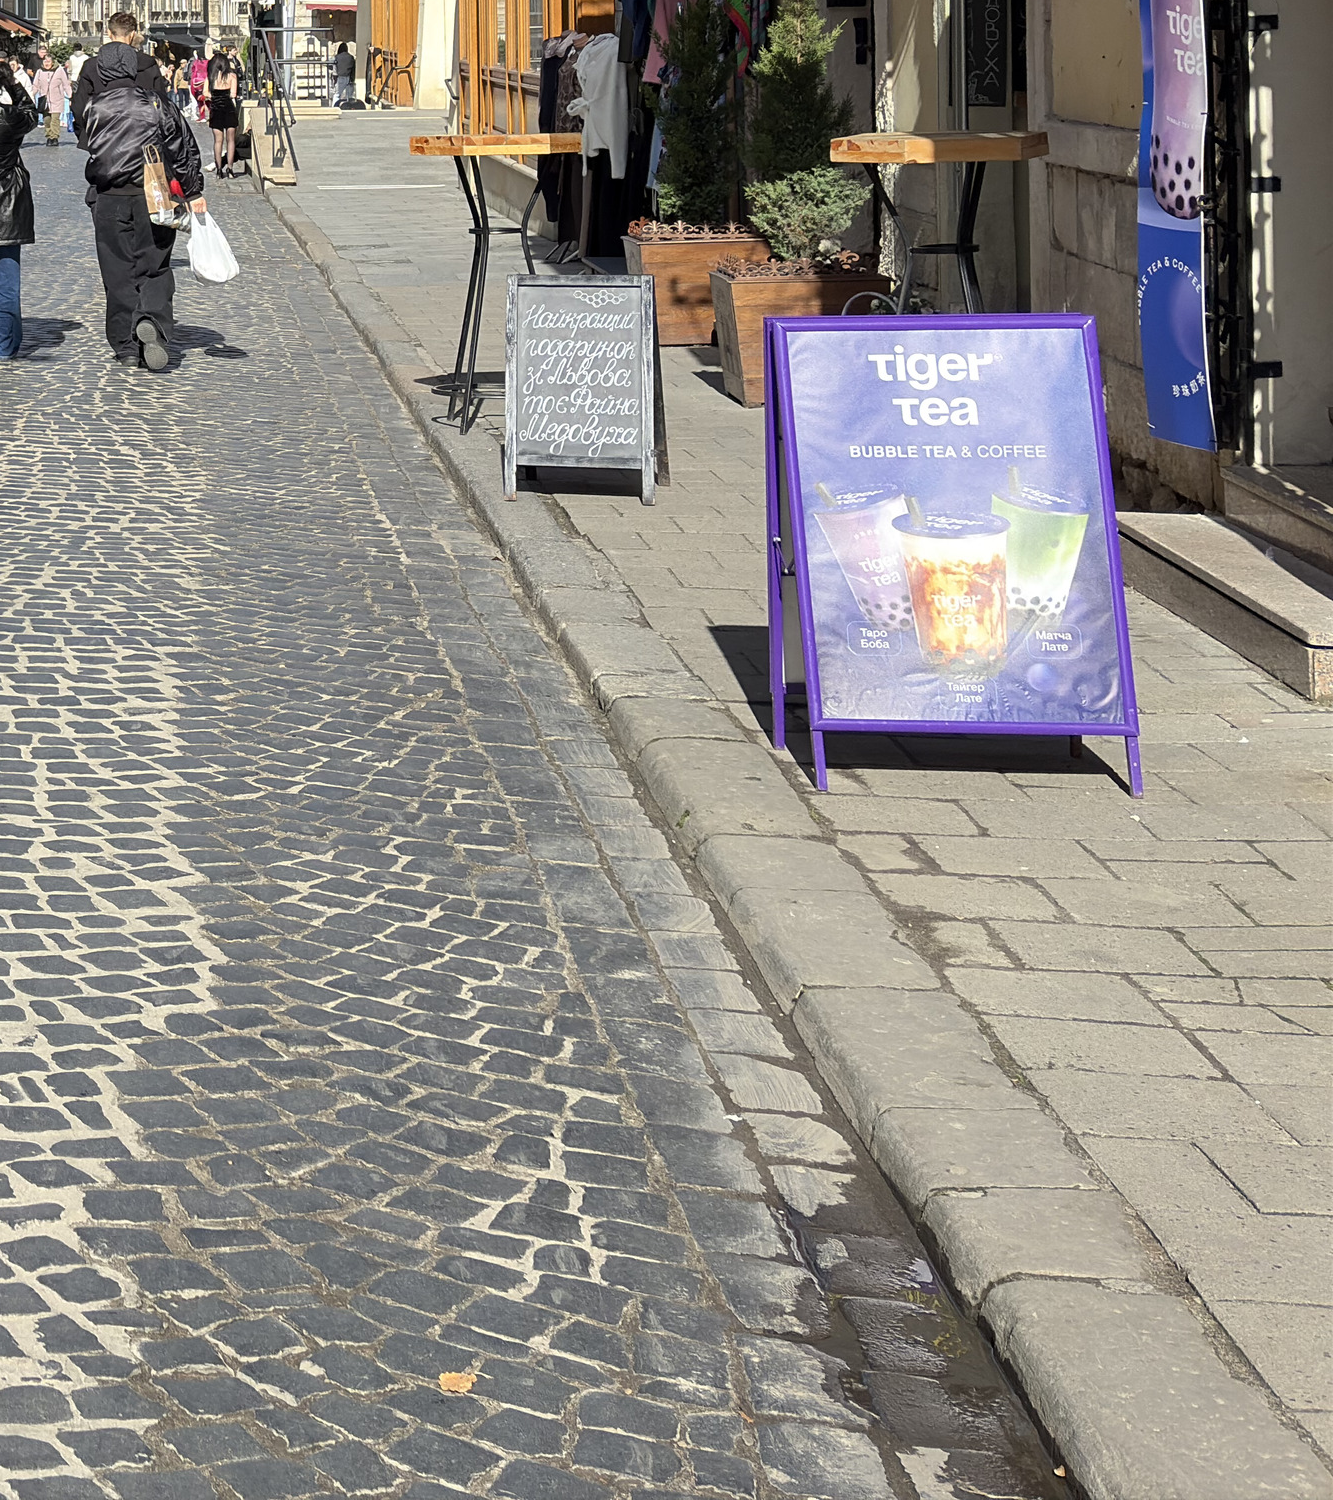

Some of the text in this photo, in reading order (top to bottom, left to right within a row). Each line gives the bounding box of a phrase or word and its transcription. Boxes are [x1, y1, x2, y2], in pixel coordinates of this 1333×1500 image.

[1147, 259, 1163, 276] TEA
[1164, 256, 1171, 267] &
[1172, 258, 1203, 294] COFFEE
[521, 338, 638, 370] подарунок
[547, 358, 632, 387] Львова
[867, 344, 994, 391] tiger
[1171, 371, 1206, 398] 珍珠奶茶
[891, 396, 980, 427] tea
[519, 414, 638, 458] Медовуха
[849, 445, 1048, 459] BUBBLE TEA & COFFEE
[858, 550, 901, 573] tiger
[871, 570, 902, 588] tea
[931, 592, 982, 611] tiger
[941, 611, 978, 629] tea
[859, 628, 888, 640] Таро
[1035, 630, 1073, 642] Матча
[860, 638, 890, 650] Боба
[1041, 642, 1069, 653] Лате
[946, 681, 985, 695] Тайгер
[955, 692, 983, 704] Лате
